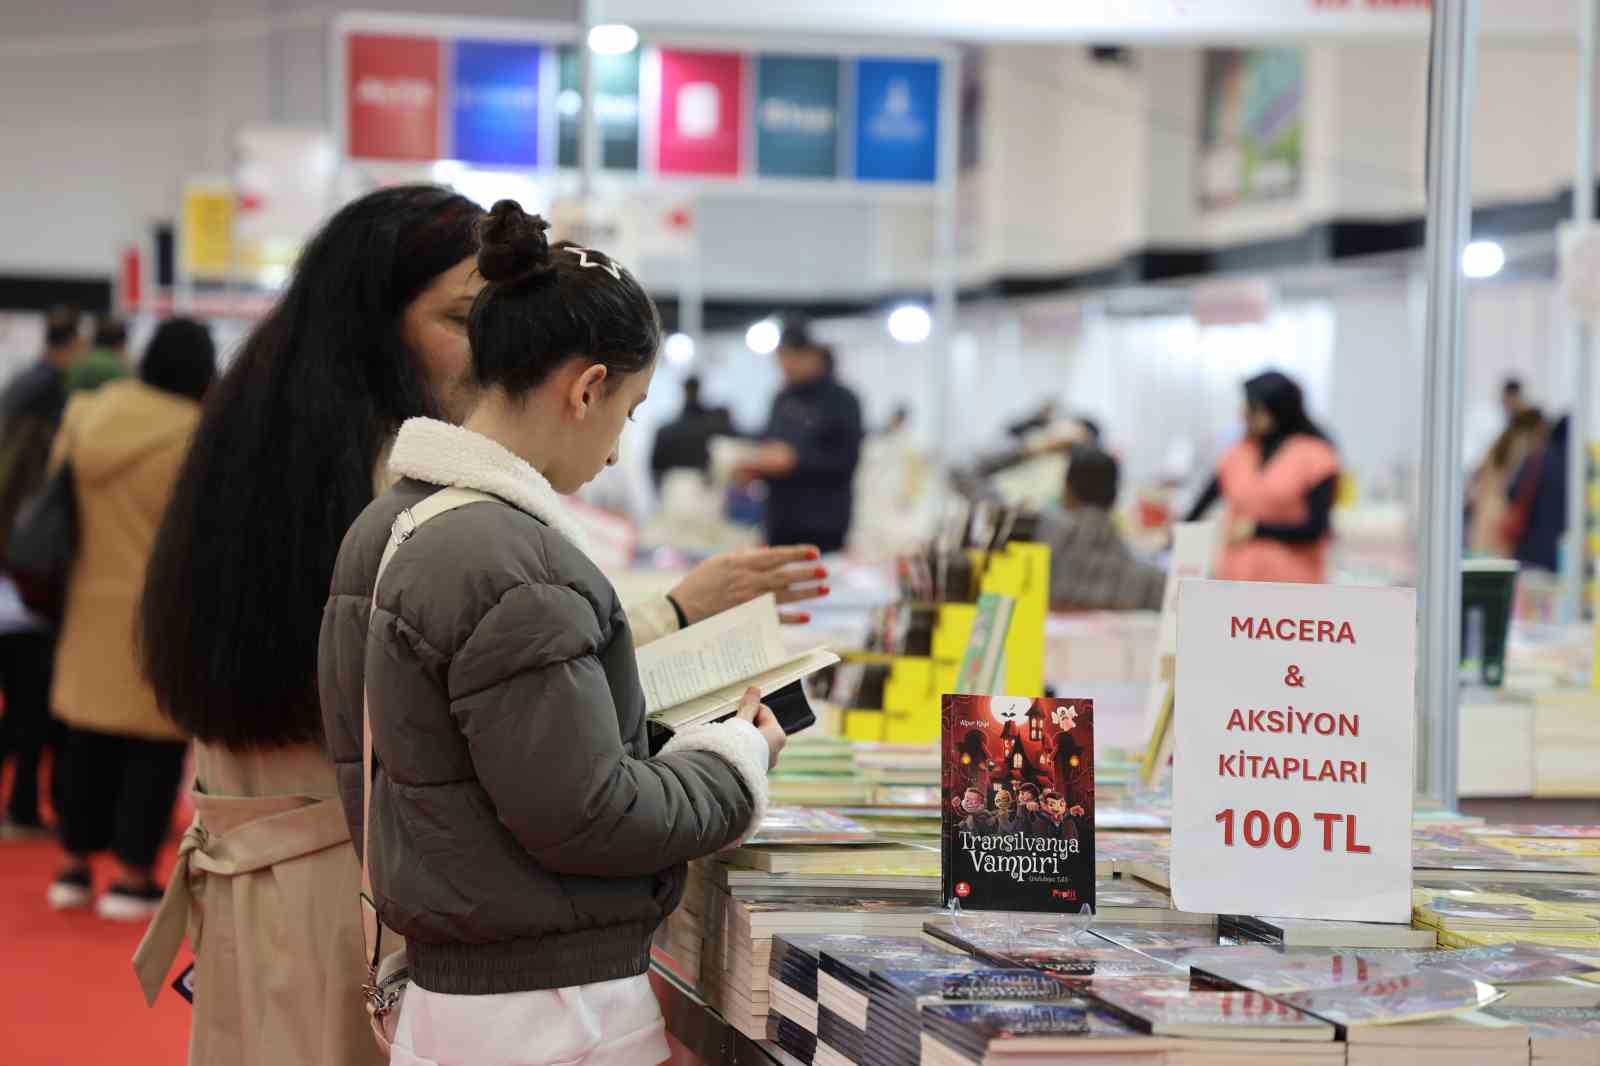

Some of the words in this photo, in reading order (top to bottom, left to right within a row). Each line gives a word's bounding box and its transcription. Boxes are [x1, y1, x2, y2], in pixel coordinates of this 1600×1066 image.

[1230, 616, 1356, 644] MACERA
[1284, 664, 1305, 688] &
[1226, 706, 1360, 737] AKSİYON
[1218, 750, 1368, 784] KİTAPLARI
[959, 831, 1080, 860] Transilvanya
[1215, 808, 1301, 850] 100
[1313, 812, 1372, 854] TL
[969, 850, 1060, 882] Vampiri
